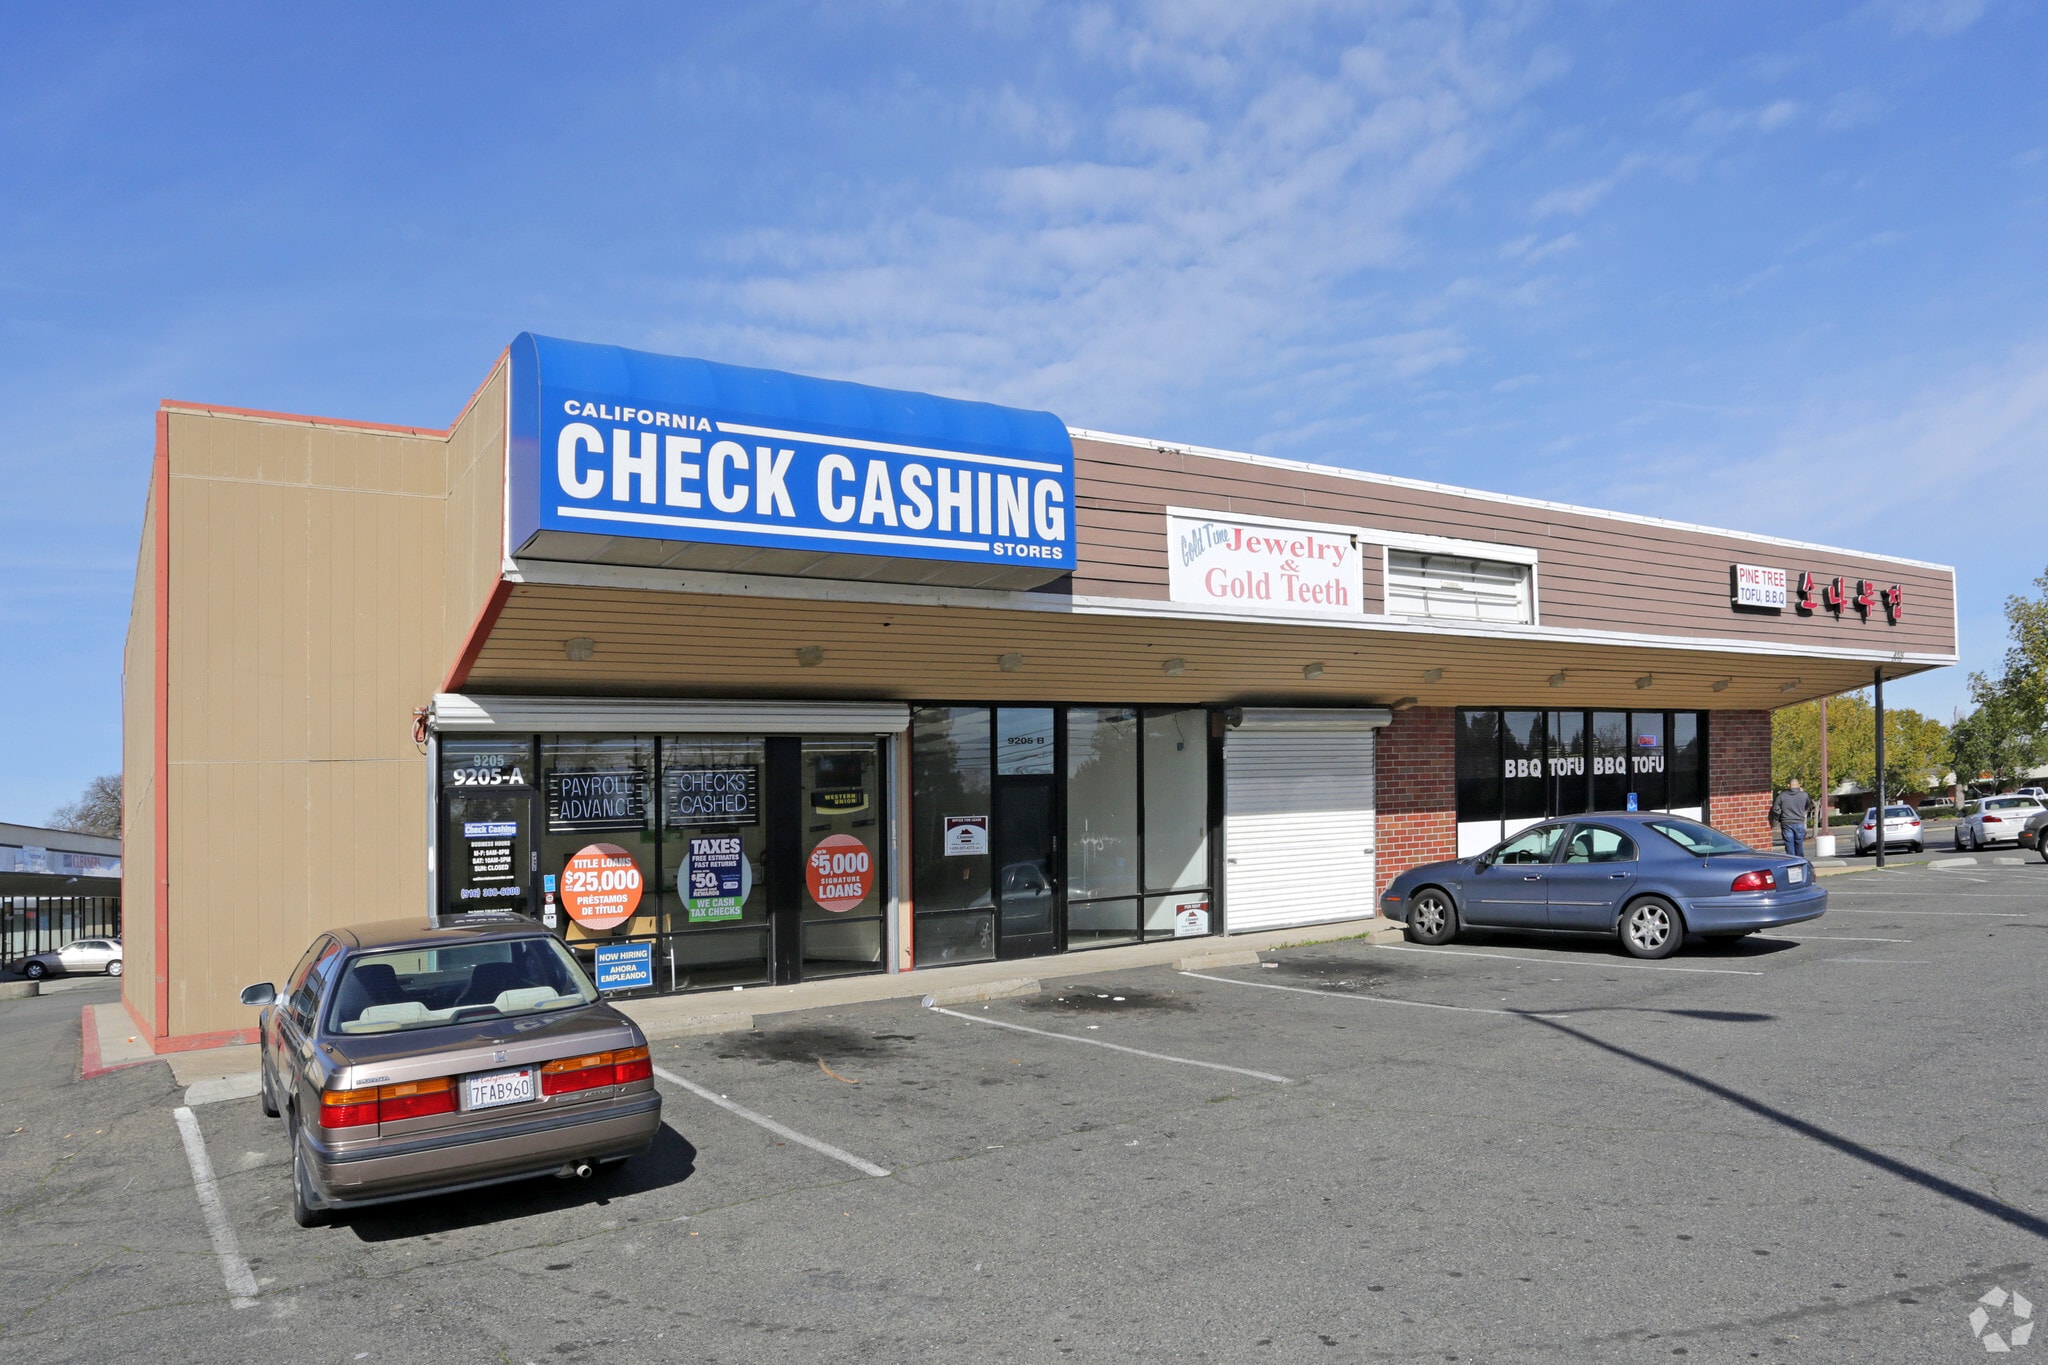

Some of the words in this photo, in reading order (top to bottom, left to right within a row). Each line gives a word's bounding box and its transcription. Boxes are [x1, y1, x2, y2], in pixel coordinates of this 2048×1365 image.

[564, 400, 712, 432] CALIFORNIA
[557, 422, 796, 518] CHECK
[817, 453, 1065, 541] CASHING
[993, 542, 1063, 560] STORES
[1181, 528, 1205, 567] Gold
[1226, 528, 1347, 567] Jewelry
[1280, 559, 1300, 573] &
[1739, 568, 1760, 585] PINE
[1761, 570, 1785, 587] TREE
[1205, 567, 1270, 600] Gold
[1280, 573, 1349, 606] Teeth
[1740, 588, 1763, 603] TOFU,
[1008, 736, 1034, 745] 9205
[1037, 736, 1045, 745] B
[473, 754, 505, 767] 9205
[1505, 758, 1542, 778] BBQ
[1548, 757, 1584, 776] TOFU
[1593, 756, 1627, 775] BBQ
[1632, 756, 1664, 774] TOFU
[453, 767, 525, 786] 9205-A
[680, 773, 745, 792] CHECKS
[562, 775, 633, 797] PAYROLL
[560, 797, 635, 819] ADVANCE
[680, 794, 748, 814] CASHED
[691, 838, 740, 855] TAXES
[573, 859, 599, 869] TITLE
[601, 857, 632, 868] LOANS
[811, 852, 869, 876] $5,000
[565, 868, 640, 893] $25,000
[820, 876, 860, 884] SIGNATURE
[461, 888, 481, 899] (916)
[577, 894, 628, 905] PRÉSTAMOS
[819, 883, 863, 899] LOANS
[582, 906, 594, 915] DE
[595, 904, 624, 915] TÍTULO
[697, 898, 711, 908] WE
[712, 897, 735, 907] CASH
[691, 908, 706, 917] TAX
[708, 906, 740, 916] CHECKS
[599, 952, 618, 962] NOW
[620, 950, 648, 960] HIRING
[610, 964, 637, 973] AHORA
[601, 972, 647, 983] EMPLEANDO
[472, 1080, 529, 1104] 7FAB960
